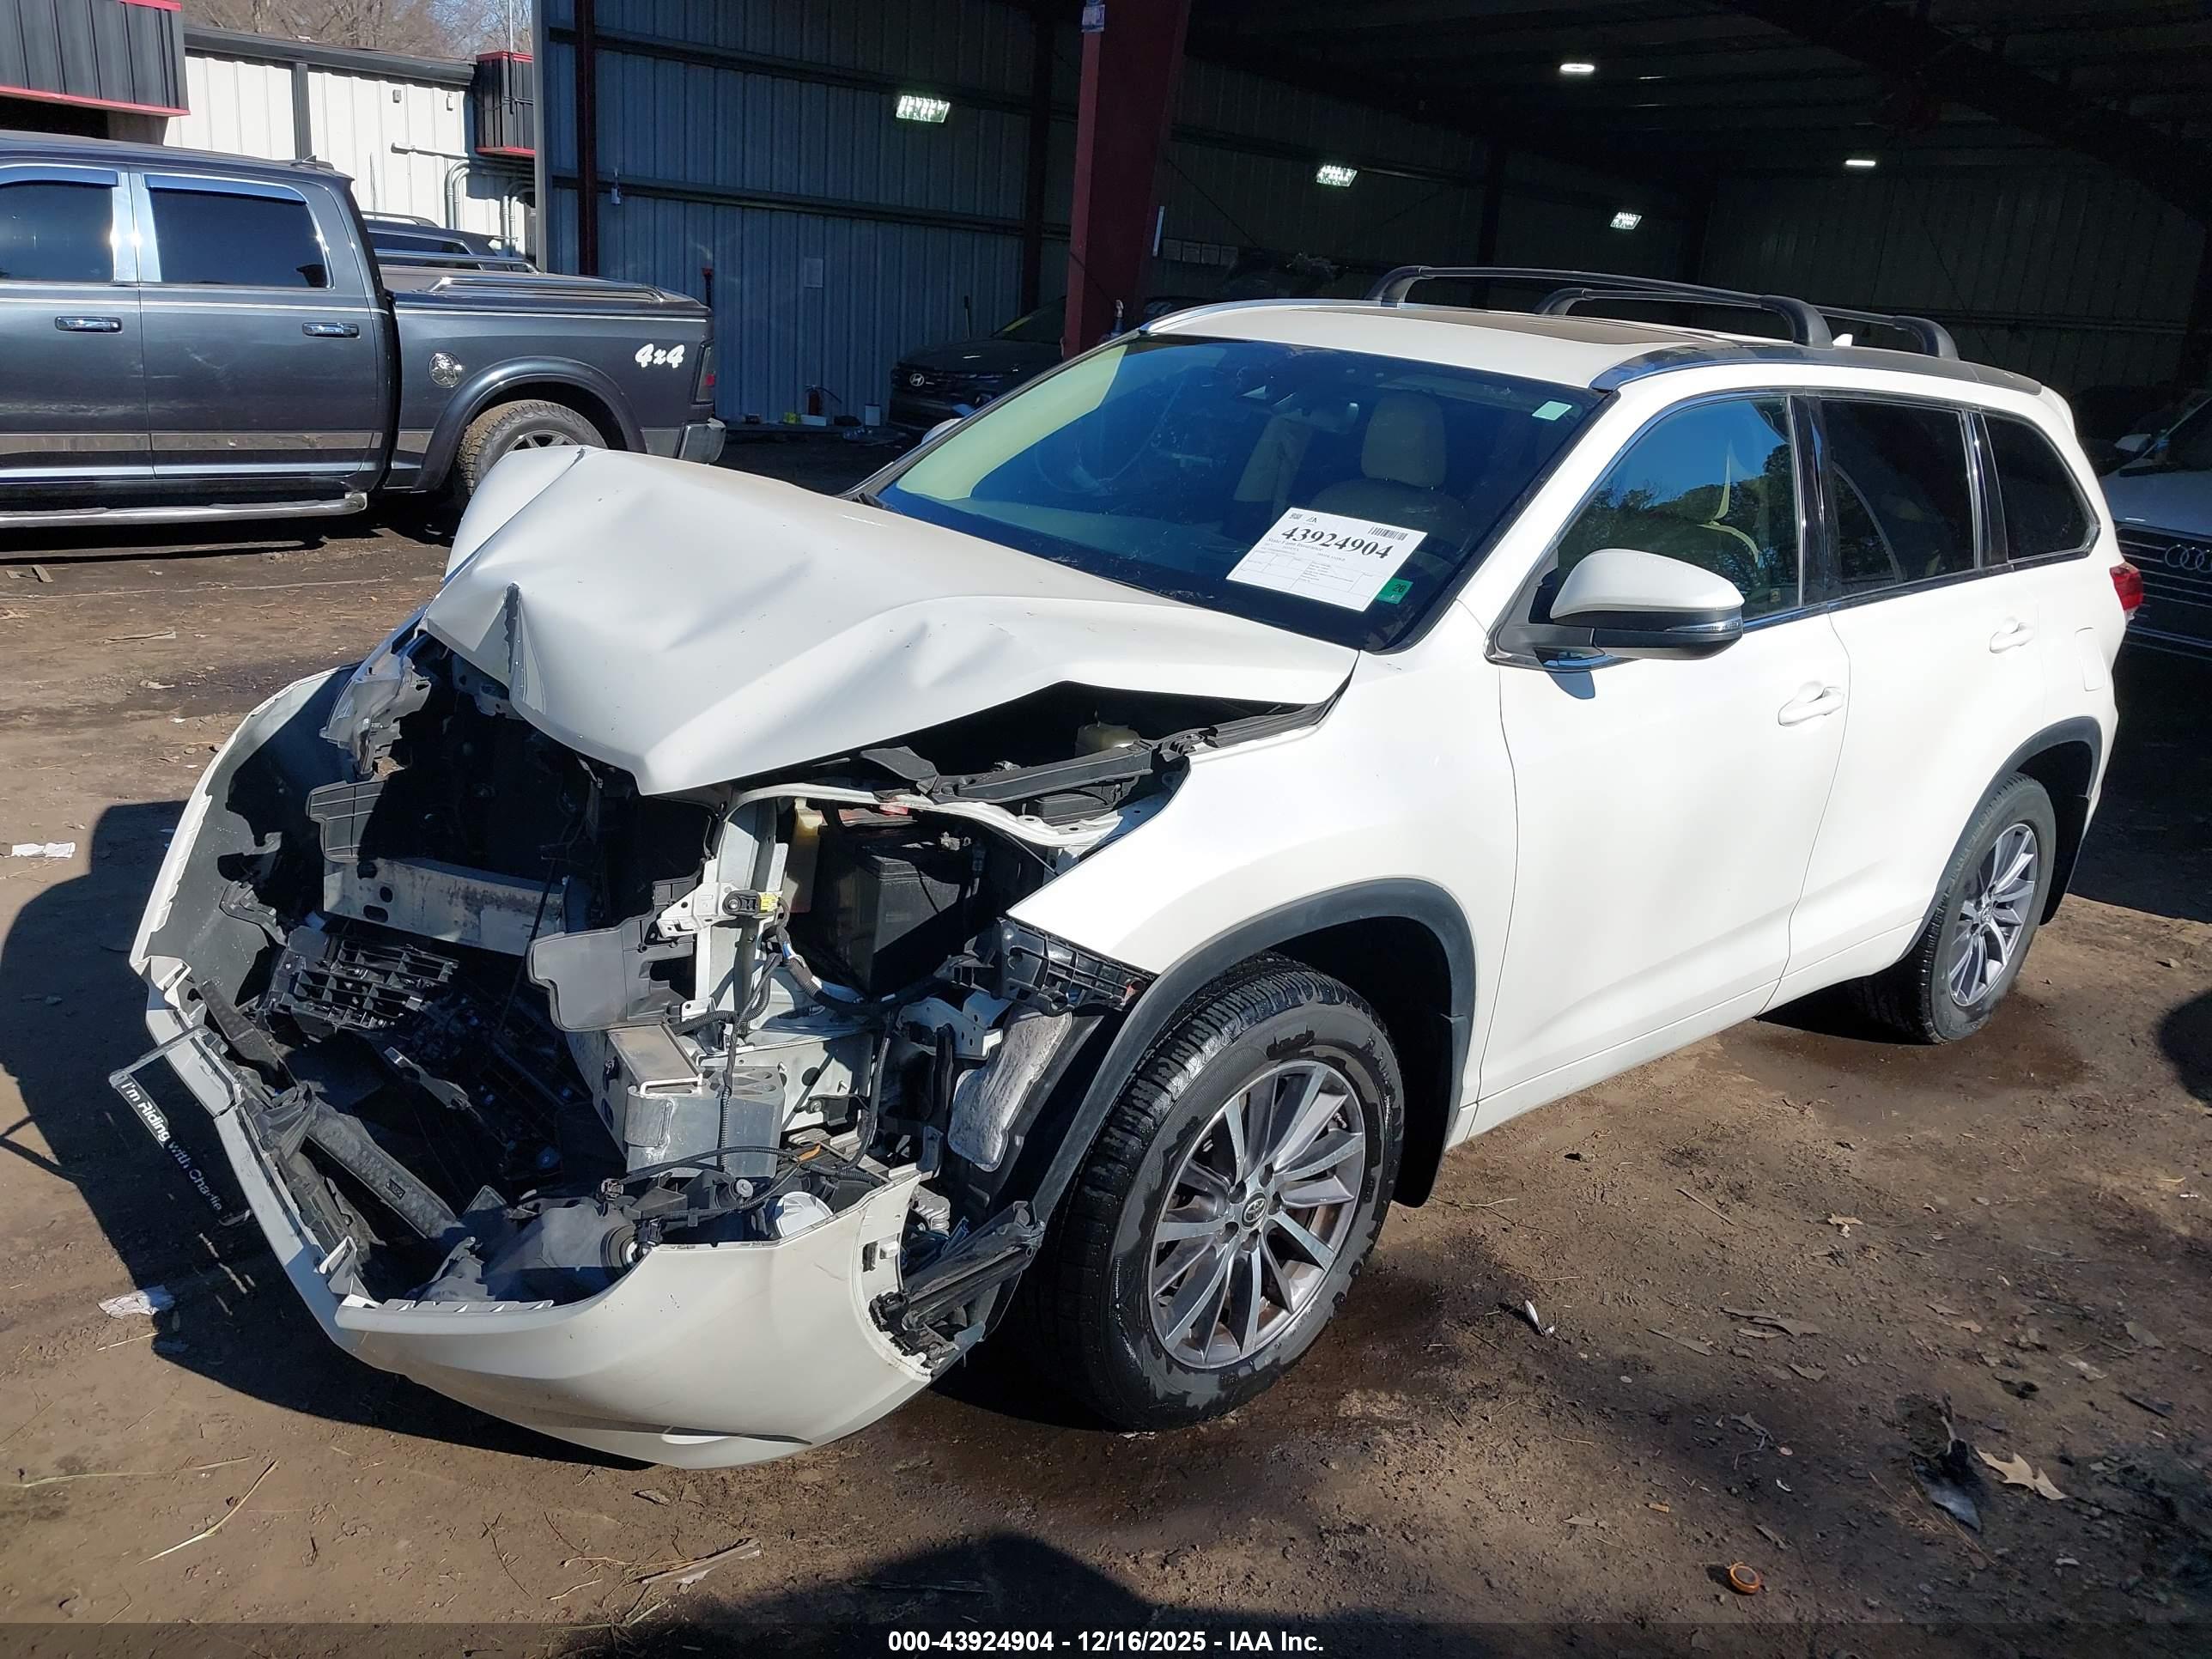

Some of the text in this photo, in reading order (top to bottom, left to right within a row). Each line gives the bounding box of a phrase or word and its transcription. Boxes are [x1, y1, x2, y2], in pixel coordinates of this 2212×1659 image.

[635, 343, 685, 368] 4x4
[1281, 526, 1394, 559] 43924904
[120, 1082, 222, 1211] I'm Riding with Charlie
